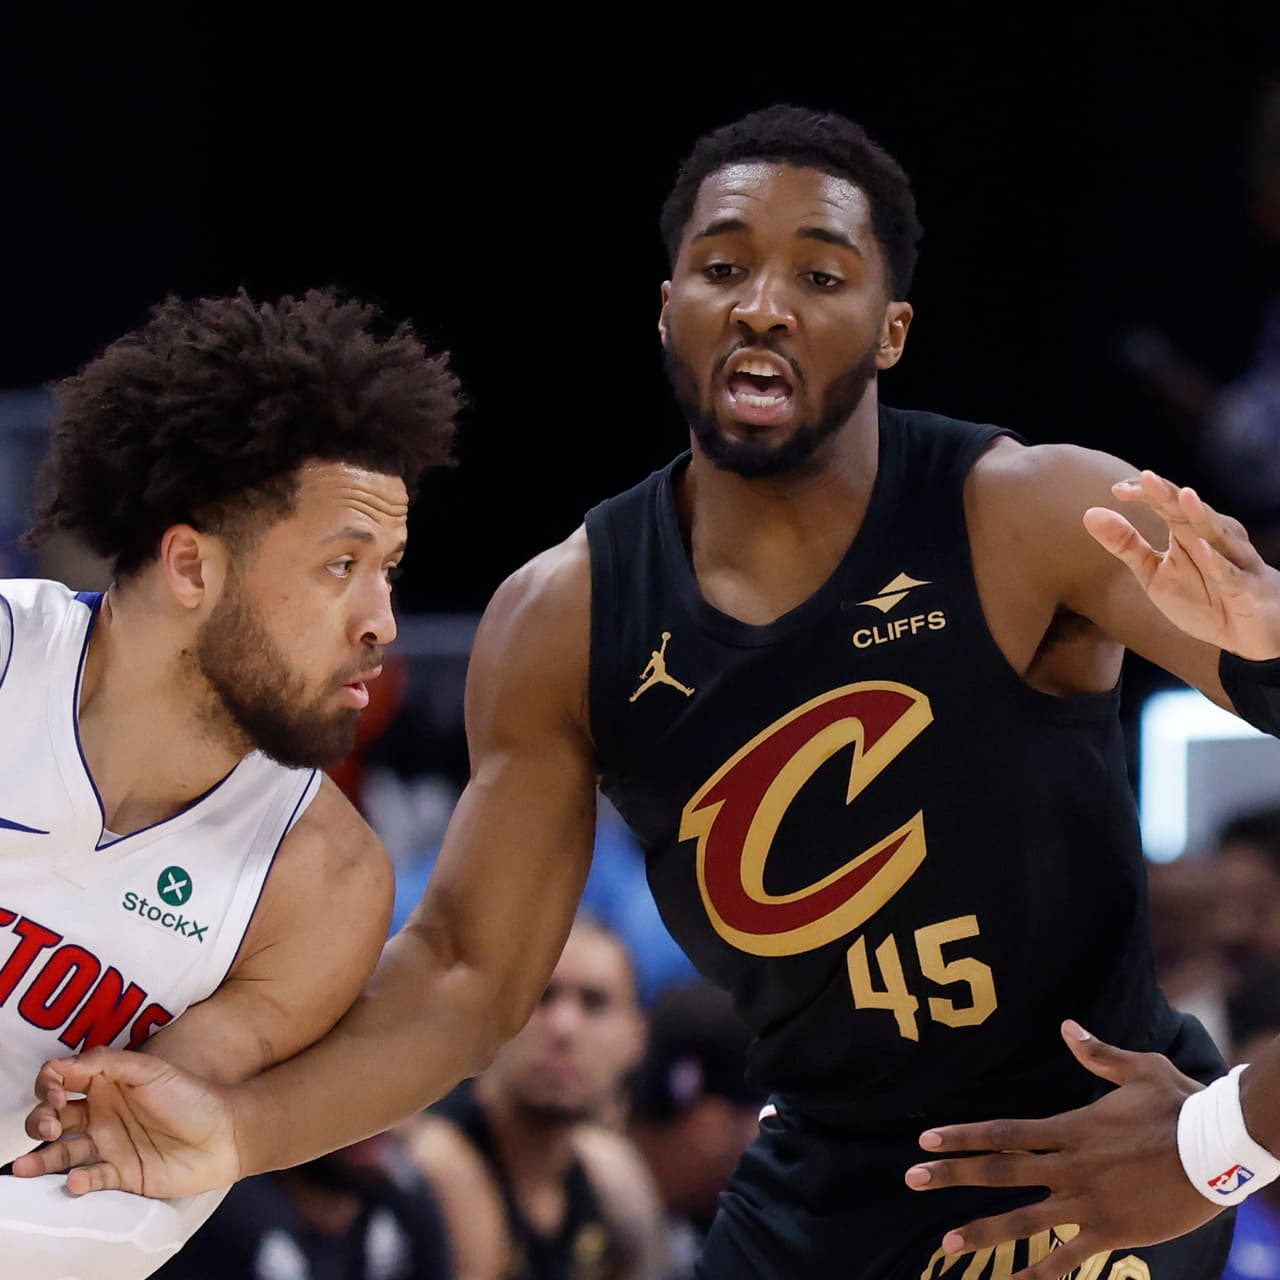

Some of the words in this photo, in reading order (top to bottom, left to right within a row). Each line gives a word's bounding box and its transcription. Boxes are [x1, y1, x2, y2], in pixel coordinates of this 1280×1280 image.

[852, 609, 947, 649] CLIFFS
[122, 891, 209, 944] StockX
[846, 913, 998, 1043] 45
